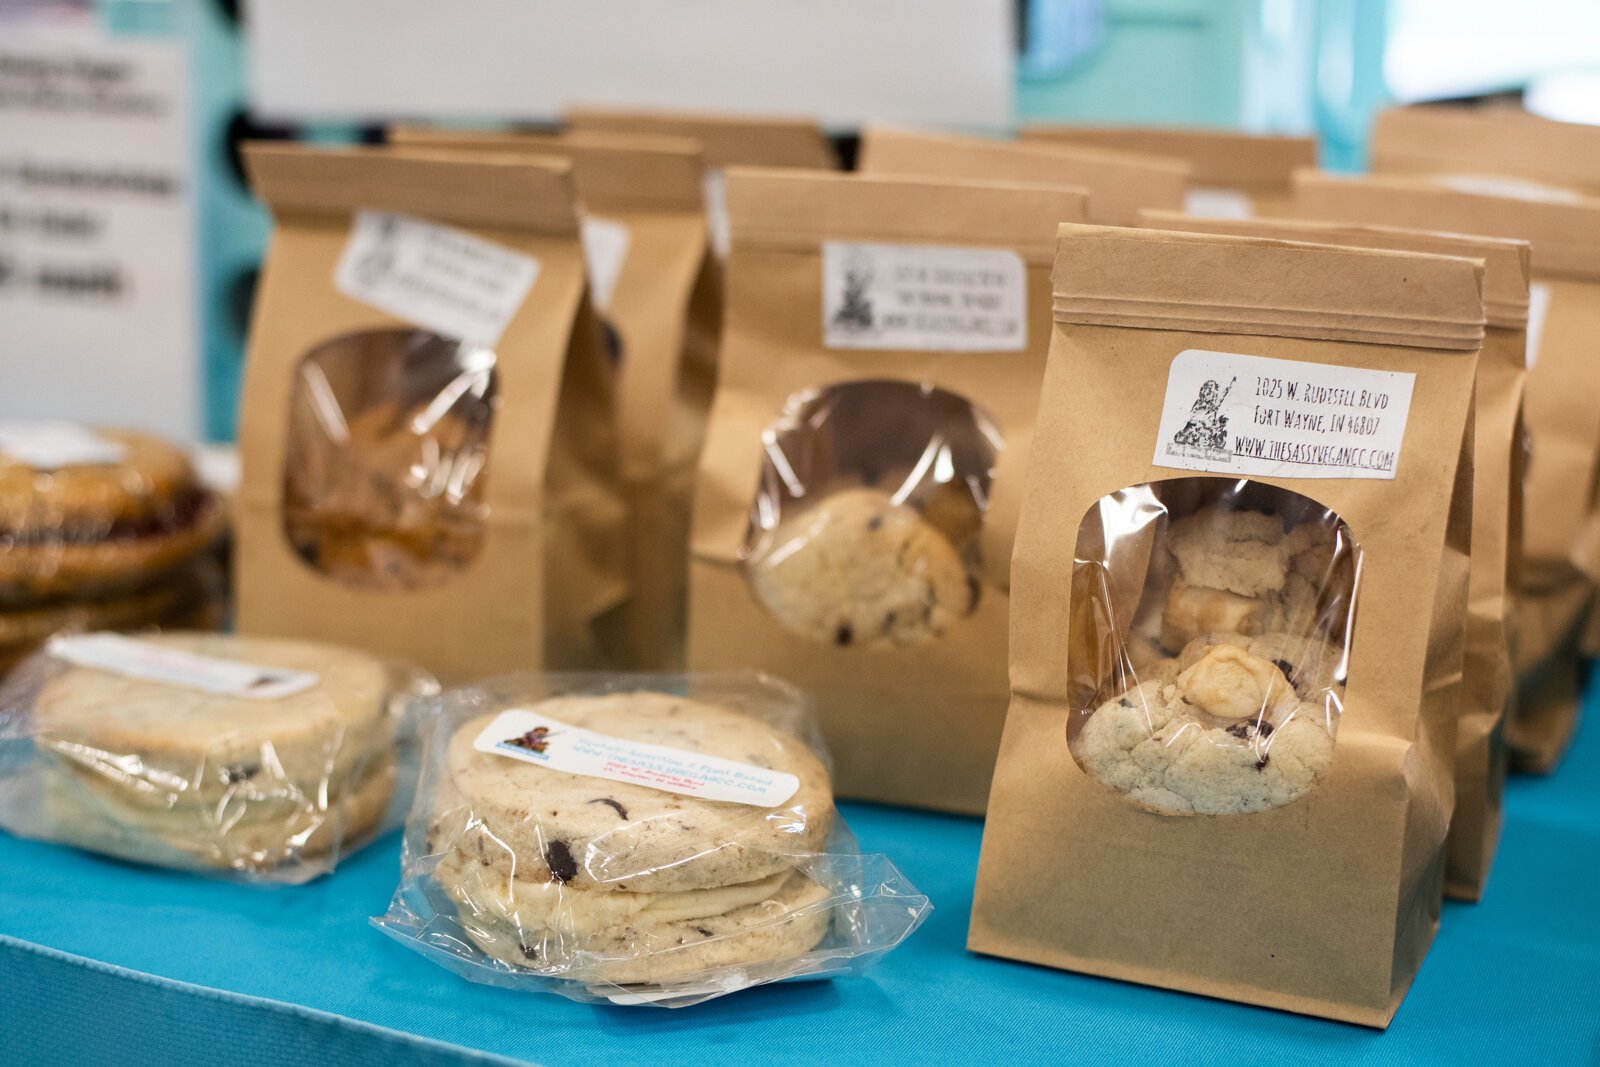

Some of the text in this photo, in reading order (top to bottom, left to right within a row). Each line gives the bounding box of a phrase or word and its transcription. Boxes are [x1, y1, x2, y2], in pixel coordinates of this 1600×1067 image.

[1255, 376, 1389, 410] 1025 W. RUDISILL BLVD
[1254, 405, 1380, 436] FORT WAYNE, IN 46807
[1235, 436, 1395, 471] WWW.THESASSYVEGANCC.COM
